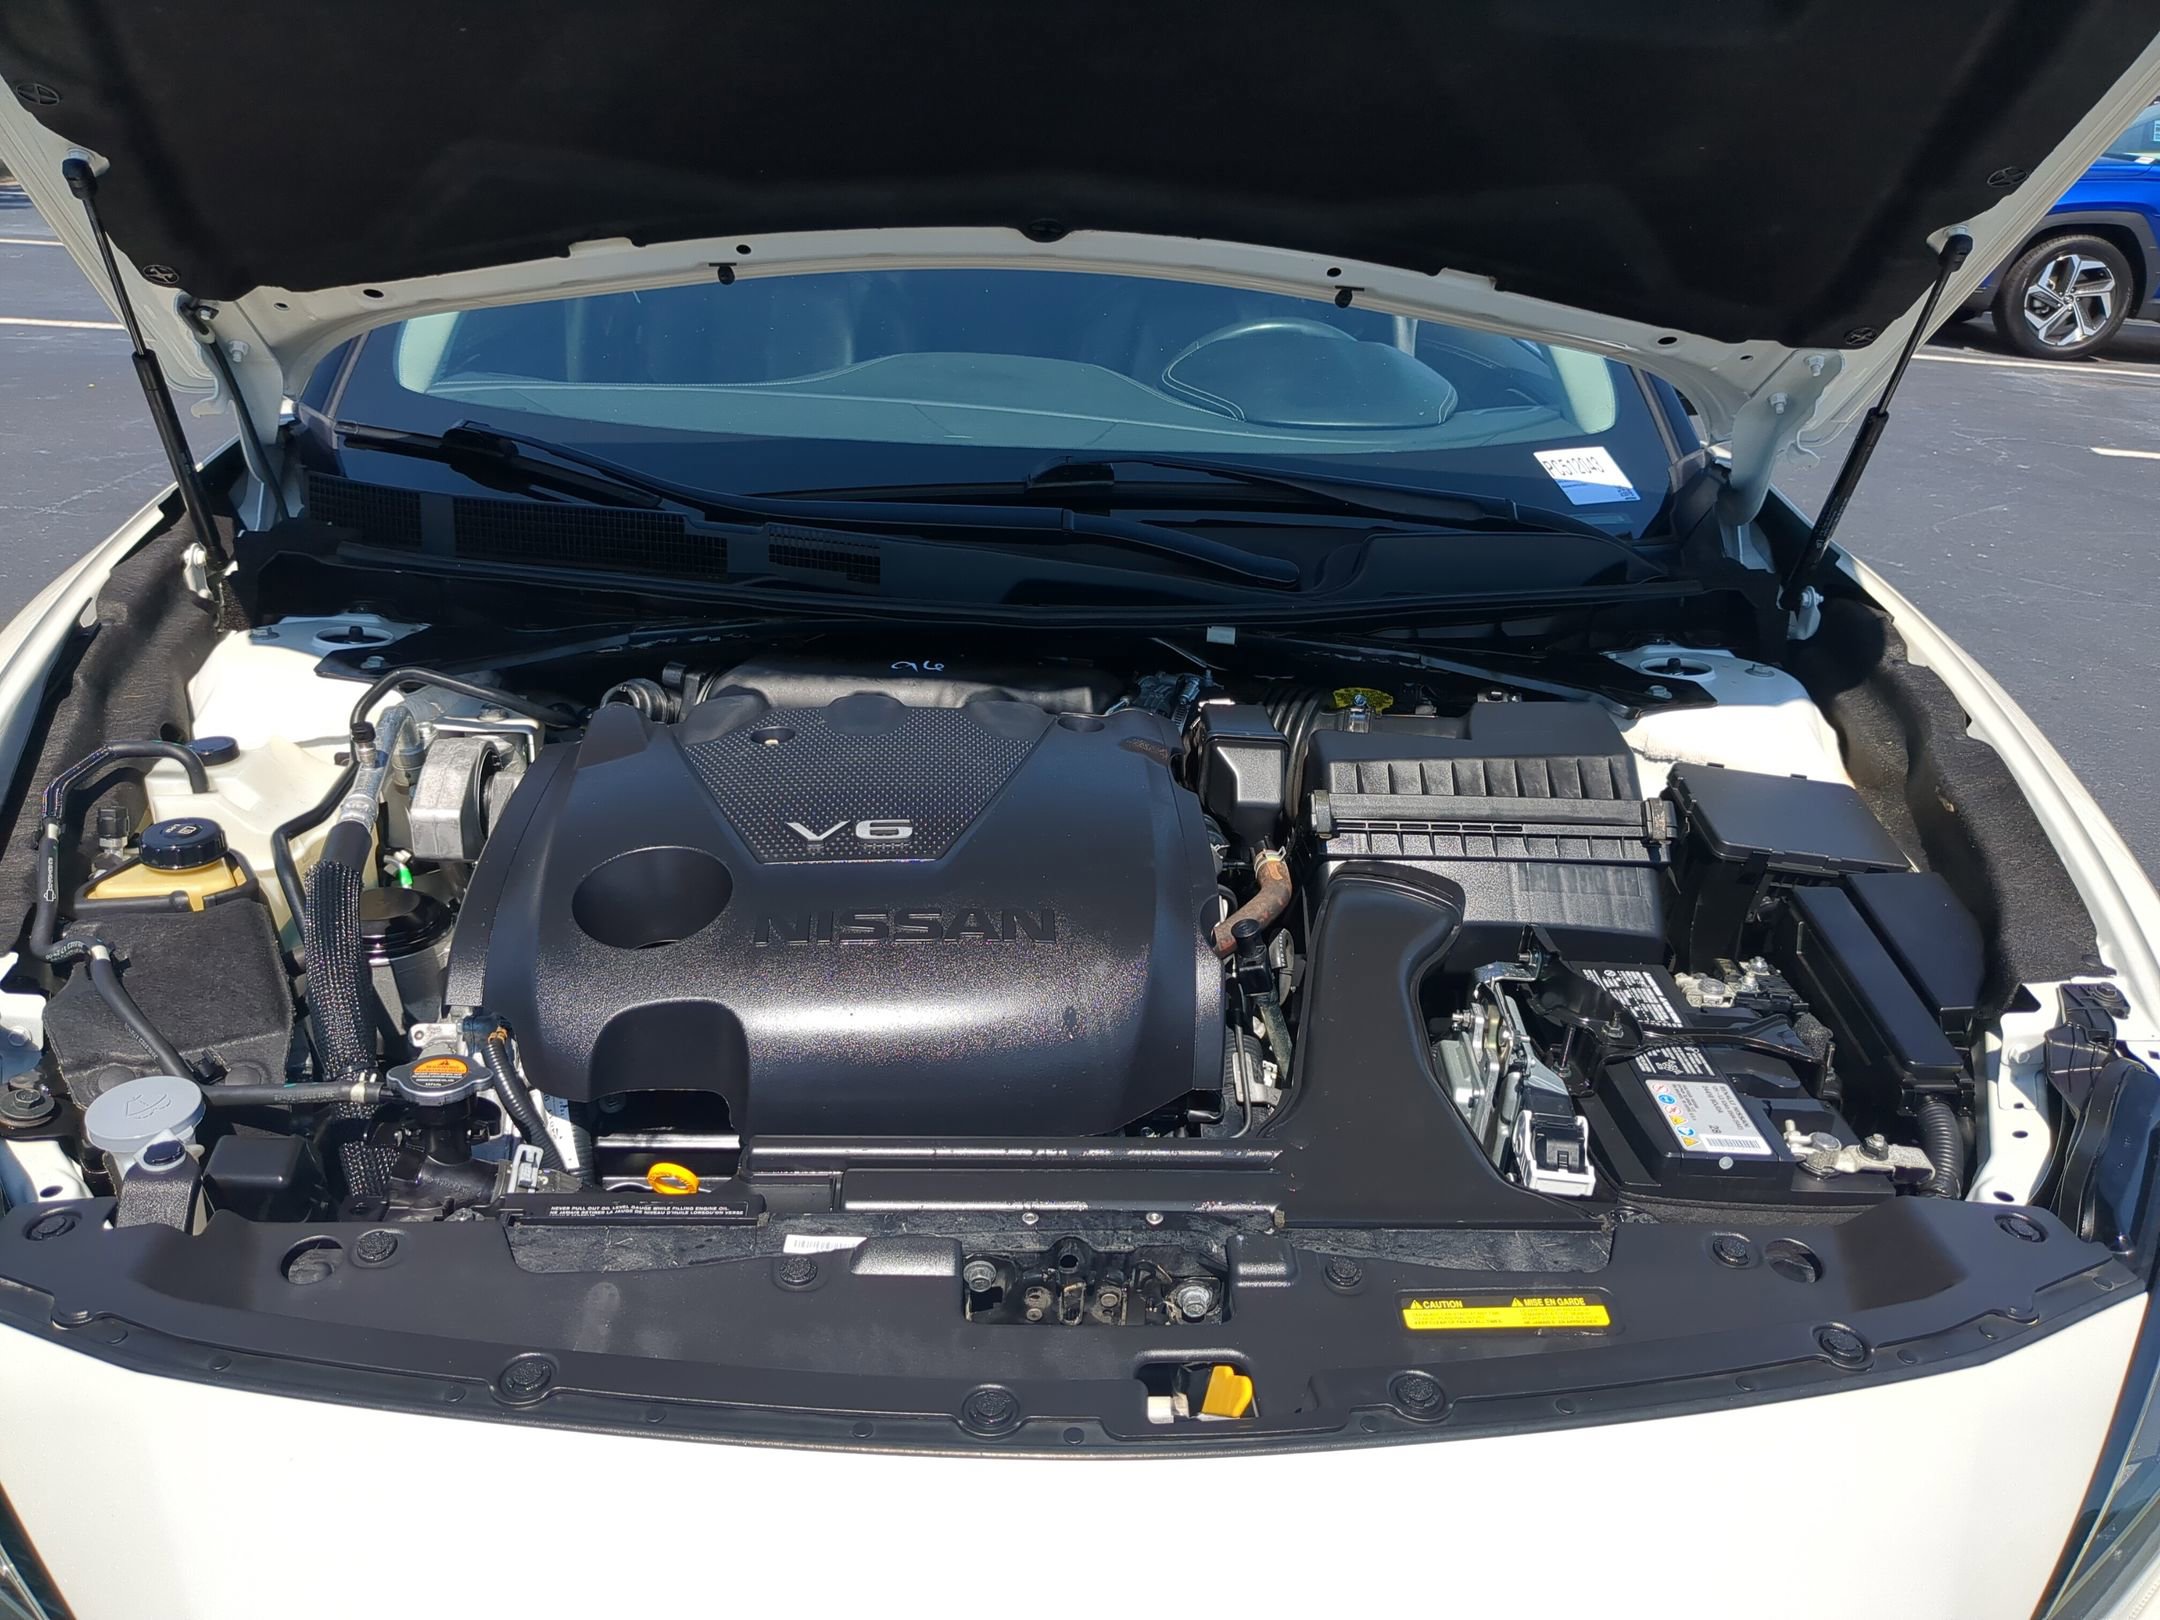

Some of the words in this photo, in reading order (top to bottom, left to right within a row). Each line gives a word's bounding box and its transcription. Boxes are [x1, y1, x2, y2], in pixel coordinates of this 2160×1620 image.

[786, 819, 914, 841] V6
[753, 907, 1057, 947] NISSAN
[1422, 1300, 1463, 1309] CAUTION
[1523, 1298, 1544, 1307] MISE
[1544, 1297, 1556, 1306] EN
[1556, 1297, 1586, 1306] GARDE
